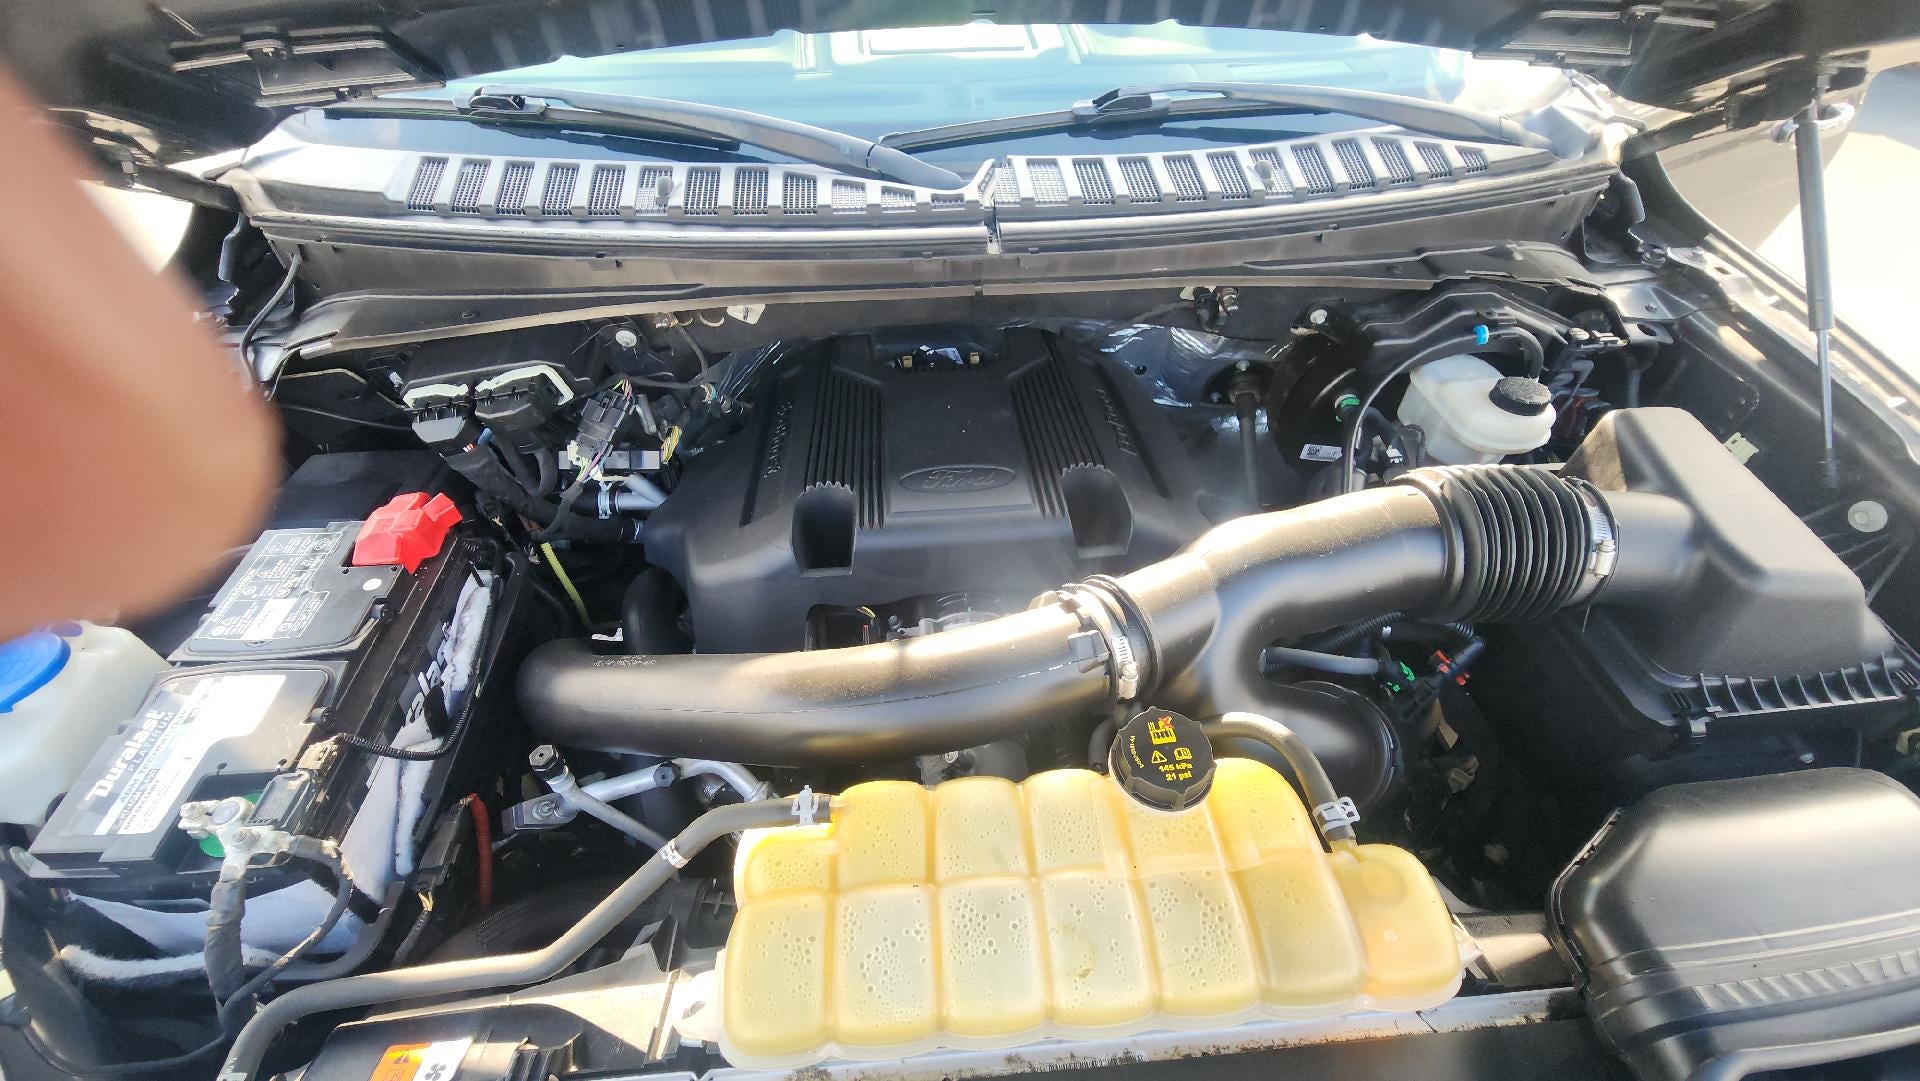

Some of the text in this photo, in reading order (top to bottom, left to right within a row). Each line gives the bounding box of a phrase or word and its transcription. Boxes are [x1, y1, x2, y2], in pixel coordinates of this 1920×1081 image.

[921, 468, 997, 490] Ford
[85, 709, 168, 801] Duralast
[128, 711, 176, 773] PLATINUM
[139, 710, 187, 777] TECHNOOGY
[1158, 762, 1193, 773] 145 kPa
[1165, 771, 1193, 782] 21 psi
